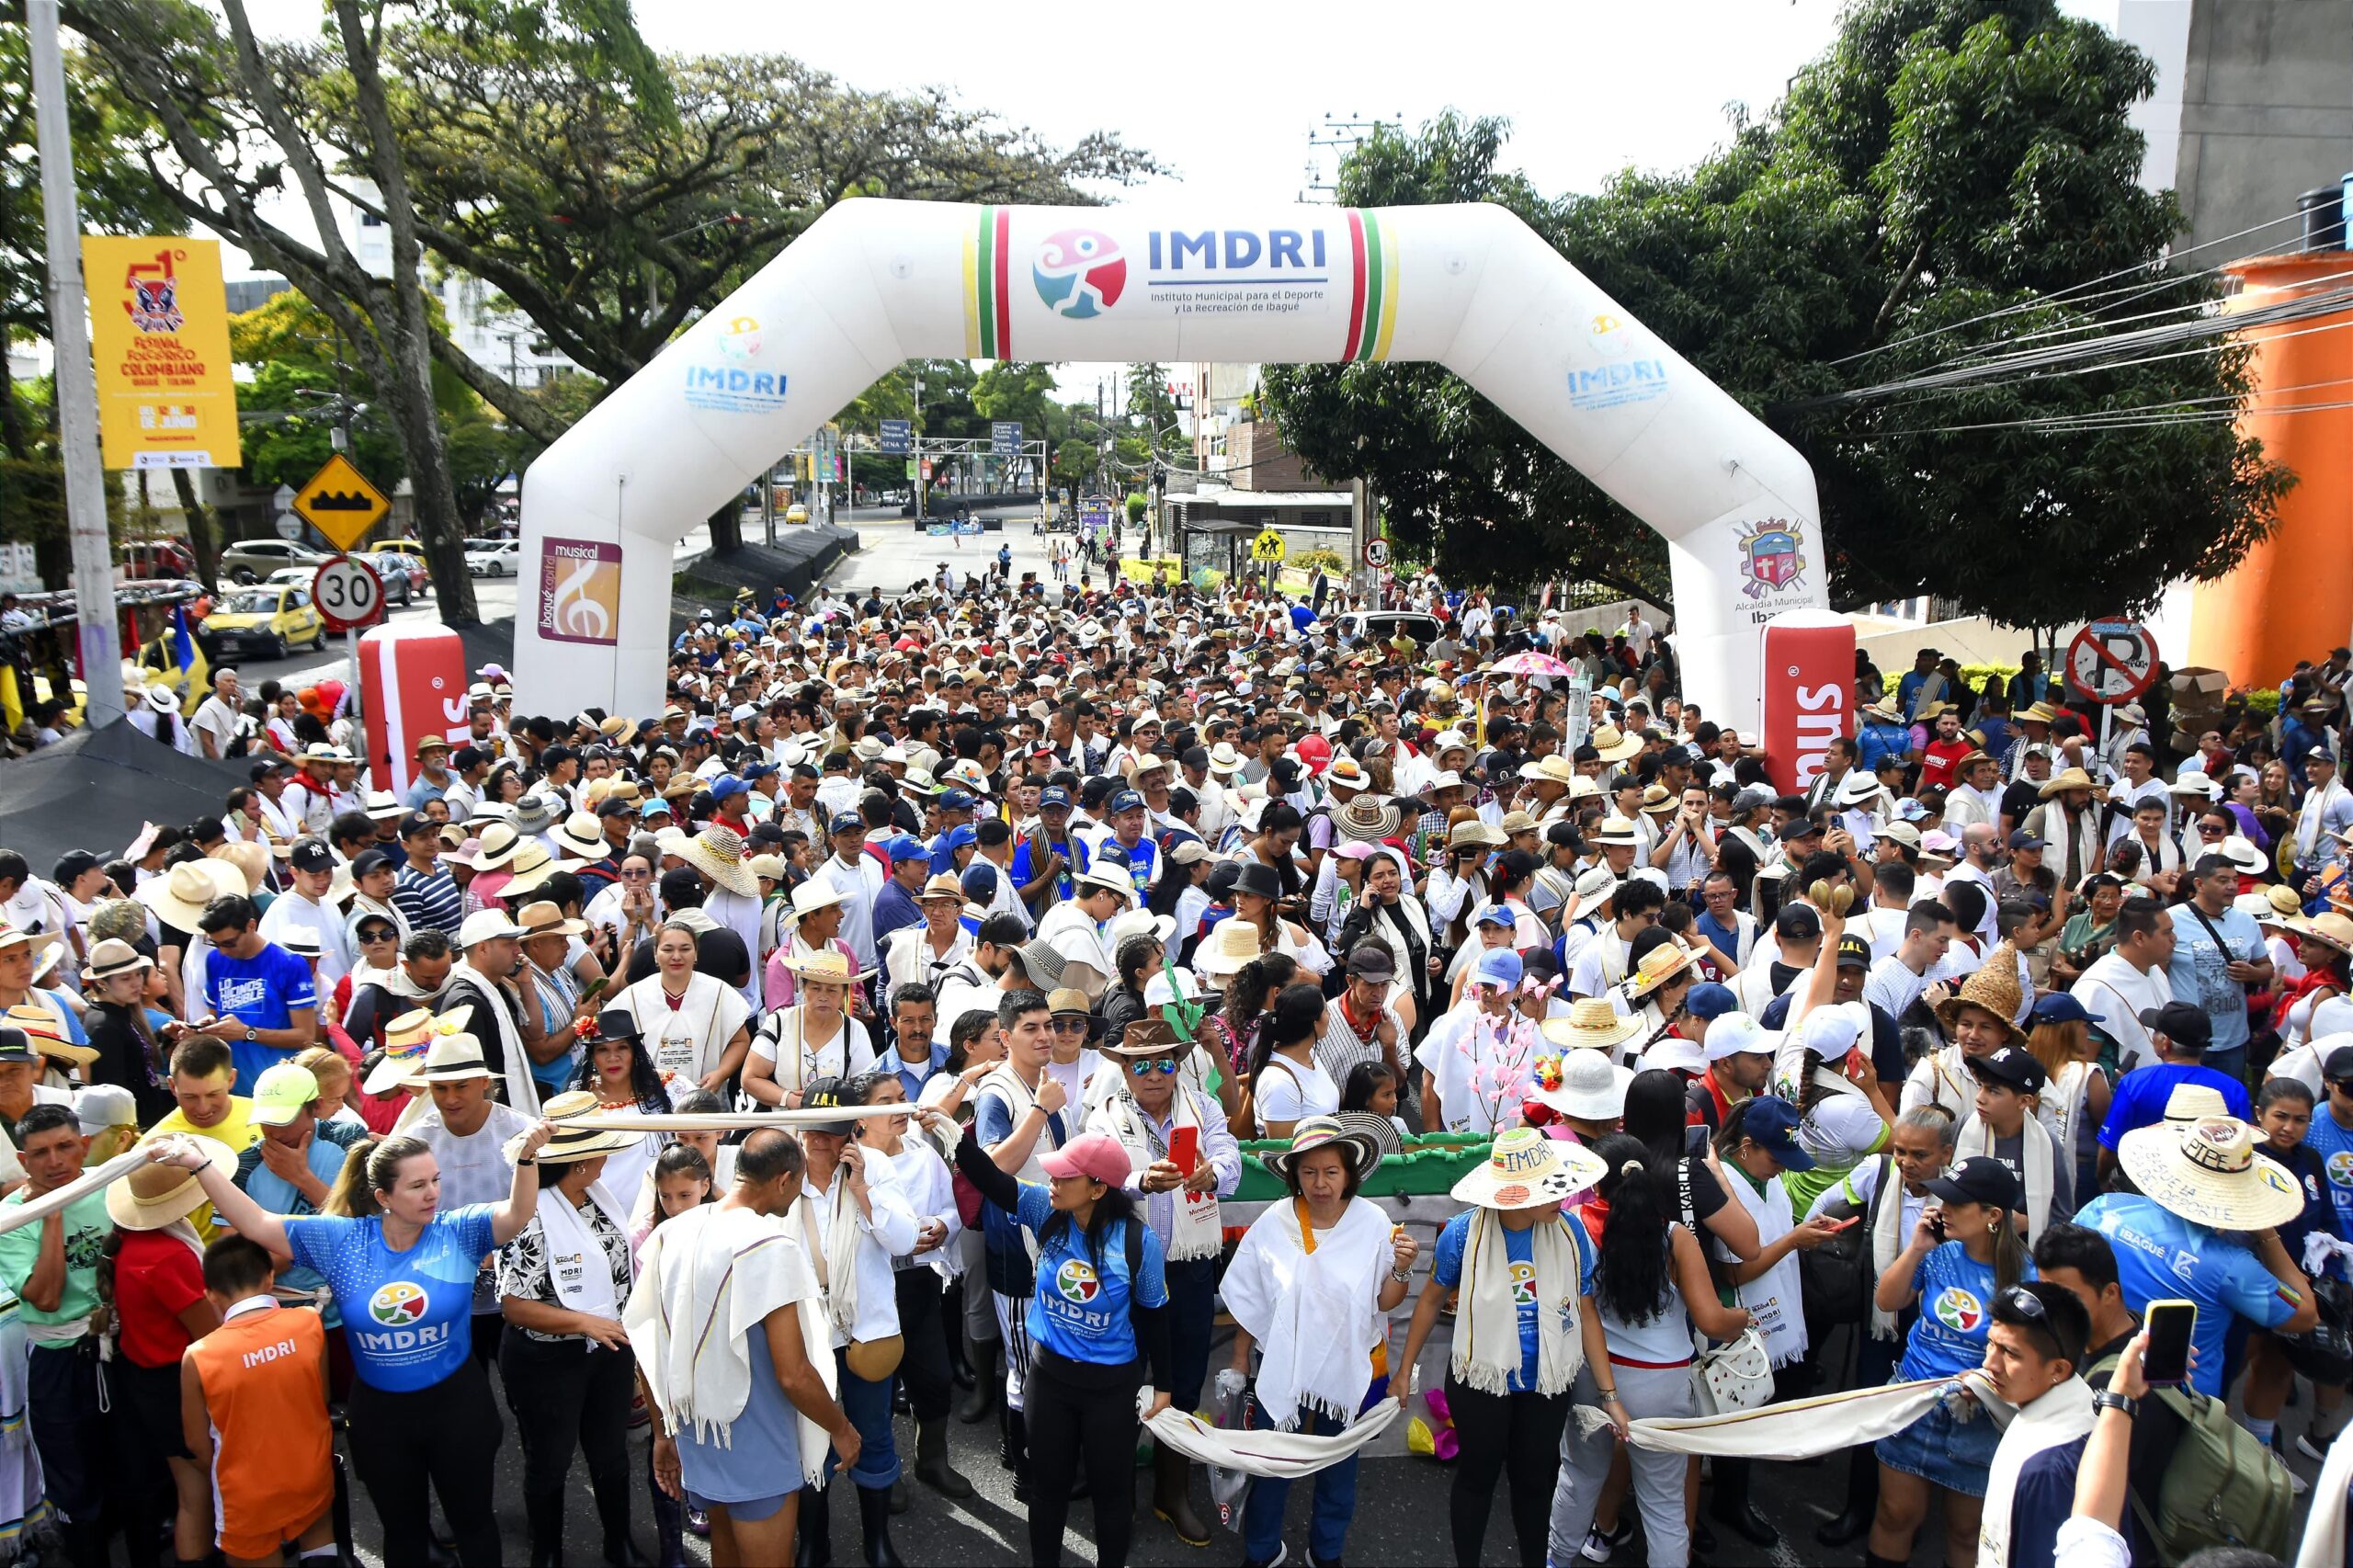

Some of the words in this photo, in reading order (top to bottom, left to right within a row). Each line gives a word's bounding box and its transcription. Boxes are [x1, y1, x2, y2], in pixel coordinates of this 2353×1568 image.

[1149, 229, 1325, 269] IMDRI
[1151, 292, 1192, 301] Instituto
[1196, 291, 1243, 302] Municipal
[1246, 292, 1268, 302] para
[1272, 290, 1280, 300] el
[1284, 290, 1324, 302] Deporte
[1175, 305, 1179, 314] y
[1183, 303, 1192, 312] la
[1196, 301, 1248, 312] Recreación
[1252, 301, 1264, 312] de
[1267, 300, 1300, 313] Ibagué
[120, 363, 206, 376] COLOMBIANO
[687, 366, 788, 396] IMDRI
[1568, 359, 1665, 393] IMDRI
[555, 544, 598, 560] musical
[325, 574, 369, 607] 30
[1735, 598, 1772, 611] Alcaldía
[1775, 595, 1813, 608] Municipal
[219, 978, 232, 992] LO
[222, 987, 266, 1011] POSIBLE
[1506, 1139, 1554, 1172] IMDRI
[1758, 1309, 1781, 1323] IMDRI
[356, 1322, 449, 1350] IMDRI
[243, 1338, 296, 1369] IMDRI
